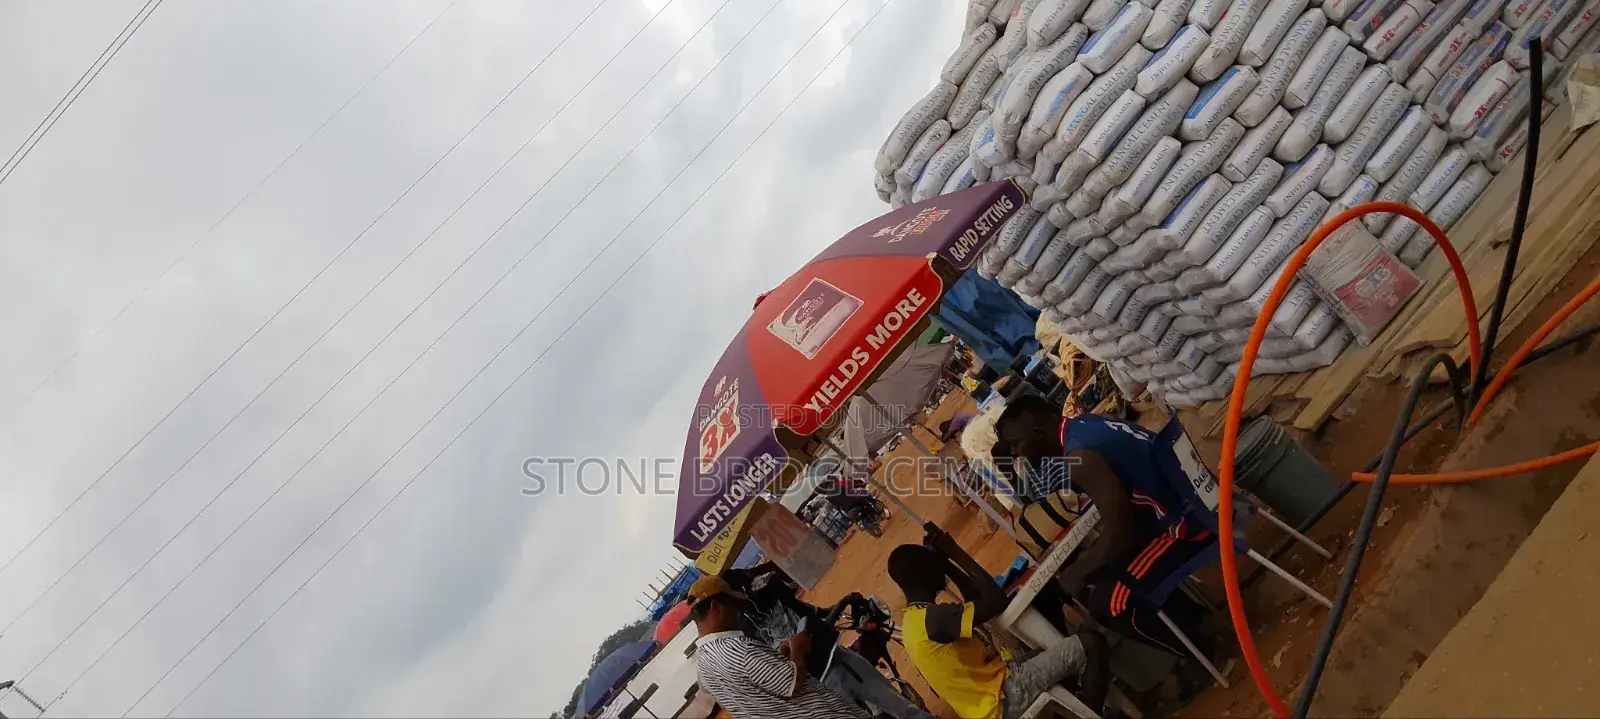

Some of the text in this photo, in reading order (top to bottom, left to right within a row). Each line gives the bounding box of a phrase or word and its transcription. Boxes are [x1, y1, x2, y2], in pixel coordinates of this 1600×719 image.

[1381, 28, 1396, 43] 3X
[1449, 35, 1463, 53] 3X
[1473, 102, 1488, 120] 3X
[949, 227, 978, 263] RAPID
[974, 194, 1014, 237] SETTING
[1151, 311, 1167, 333] MANGA
[804, 286, 928, 415] YIELDS MORE
[700, 377, 739, 432] DANGOTE
[701, 397, 738, 469] 3X
[690, 499, 732, 543] LASTS
[728, 451, 780, 507] LONGER
[707, 543, 724, 566] Dial
